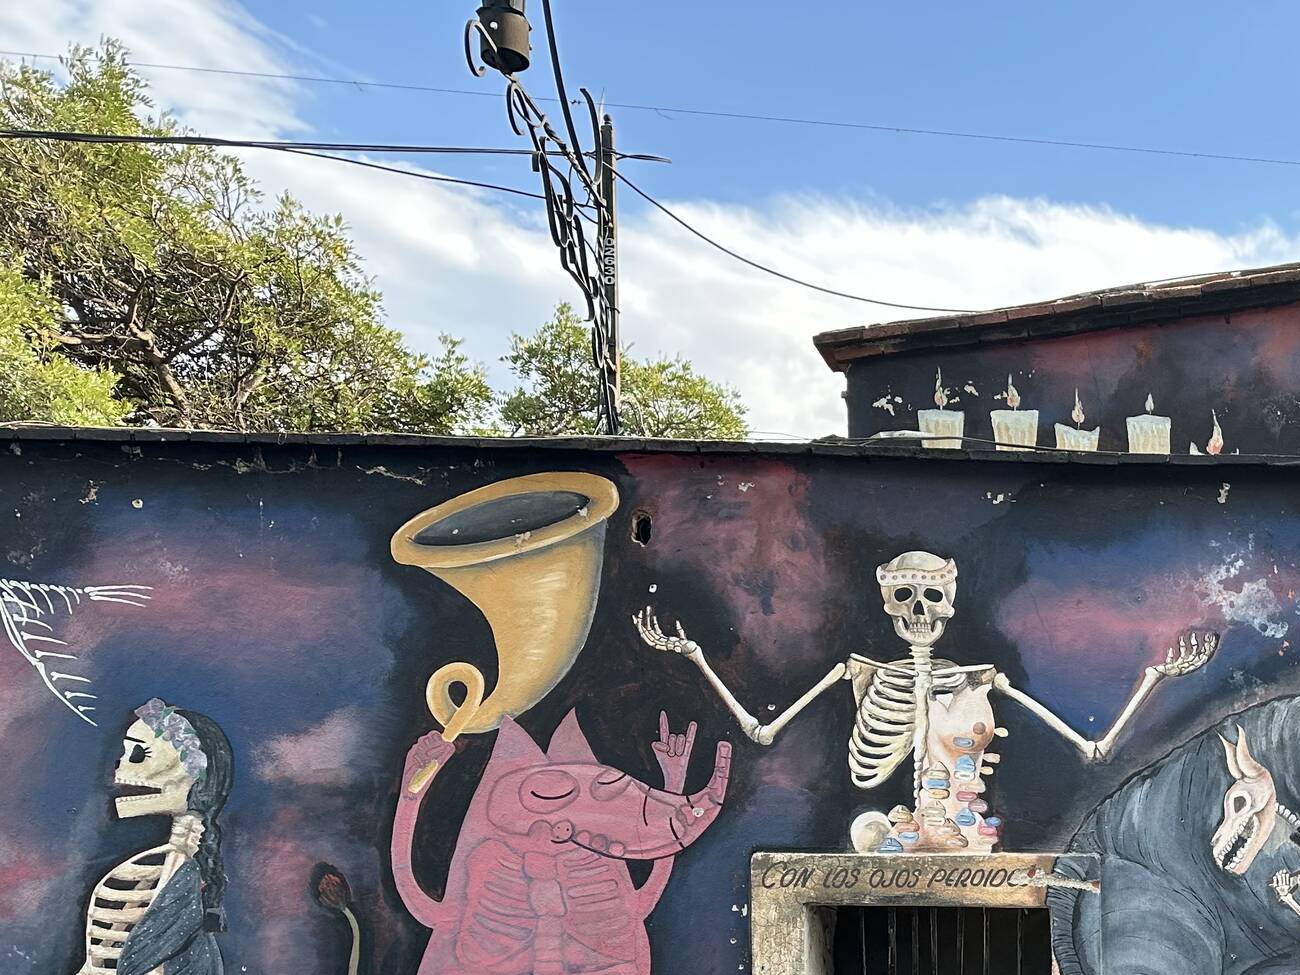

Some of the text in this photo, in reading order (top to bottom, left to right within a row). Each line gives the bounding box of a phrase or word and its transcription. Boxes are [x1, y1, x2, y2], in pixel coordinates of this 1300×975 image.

[761, 860, 1029, 889] CON LOS OJOS PERDIDO
